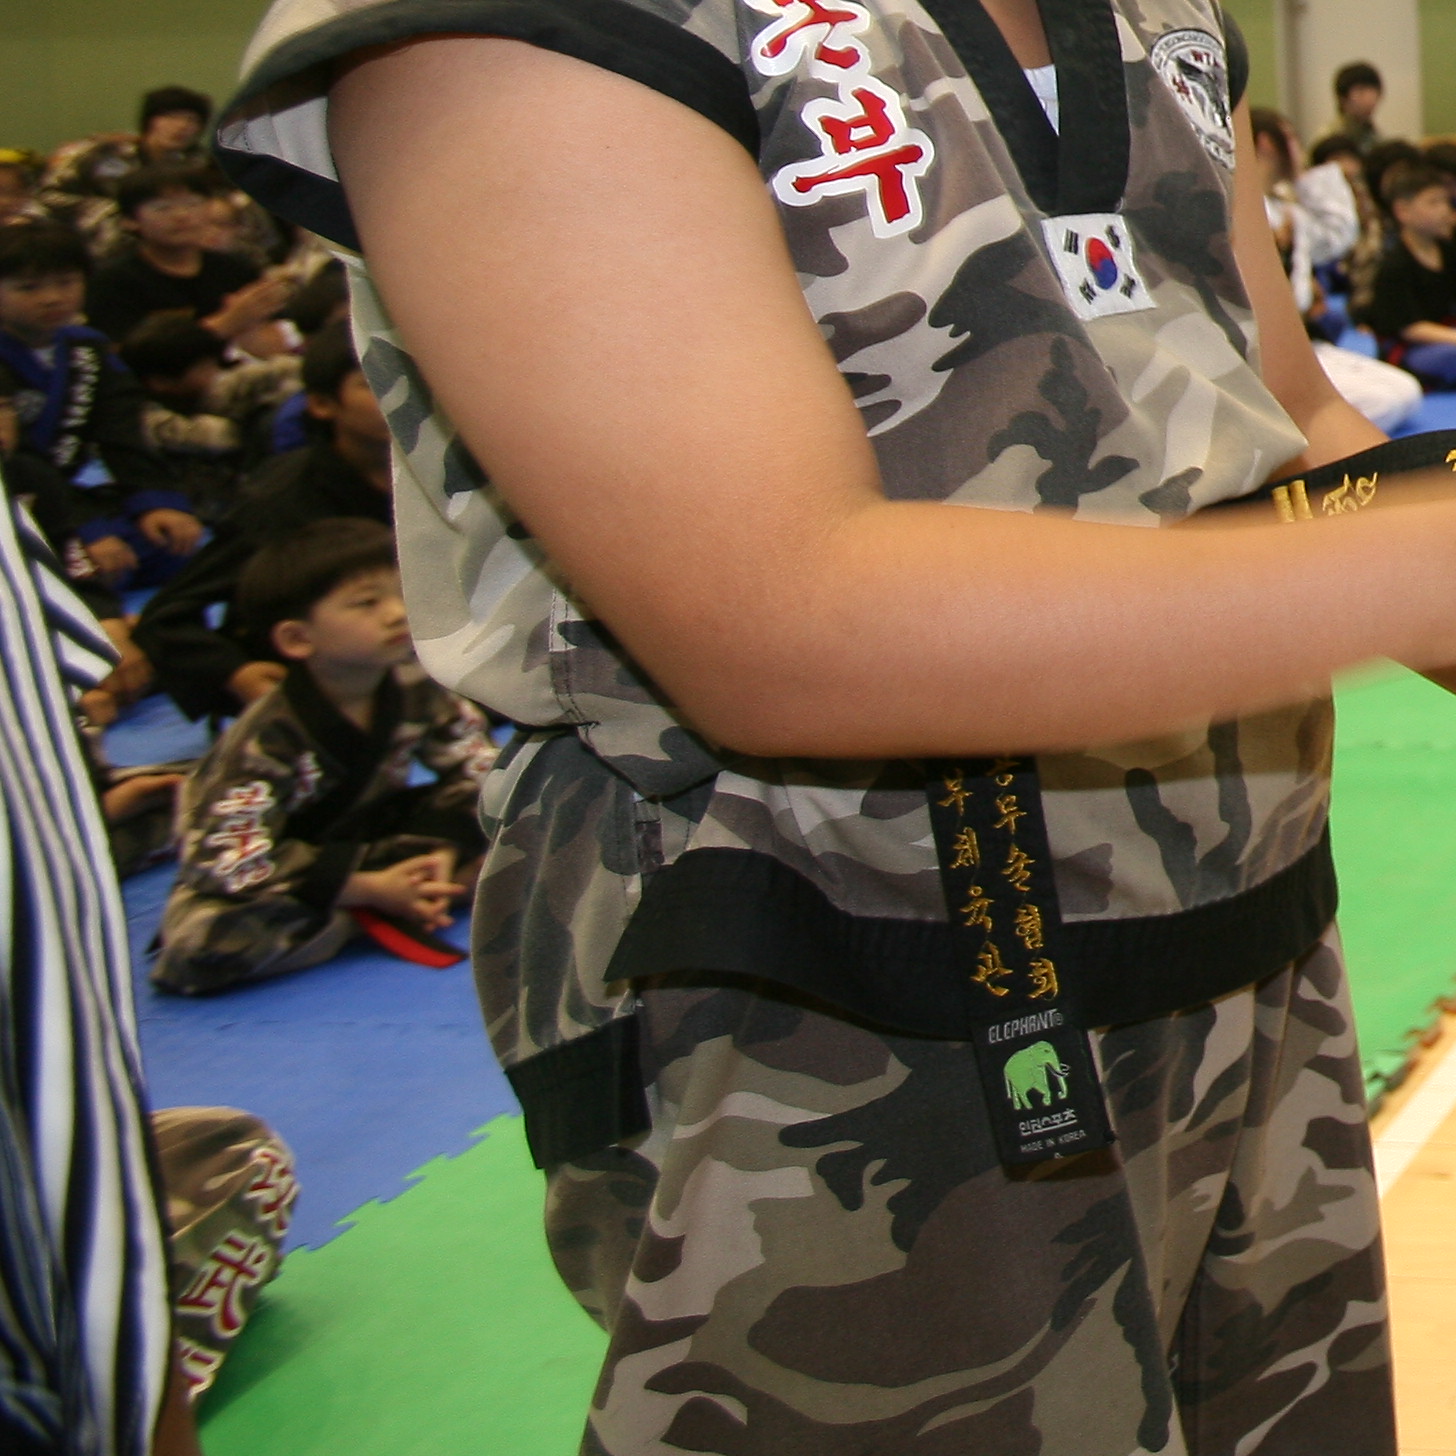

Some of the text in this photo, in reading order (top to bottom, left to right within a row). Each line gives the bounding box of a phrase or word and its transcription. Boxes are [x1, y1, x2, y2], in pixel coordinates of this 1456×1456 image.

[988, 1008, 1058, 1044] ELEPHANT
[1020, 1129, 1087, 1153] MADE IN KOREA
